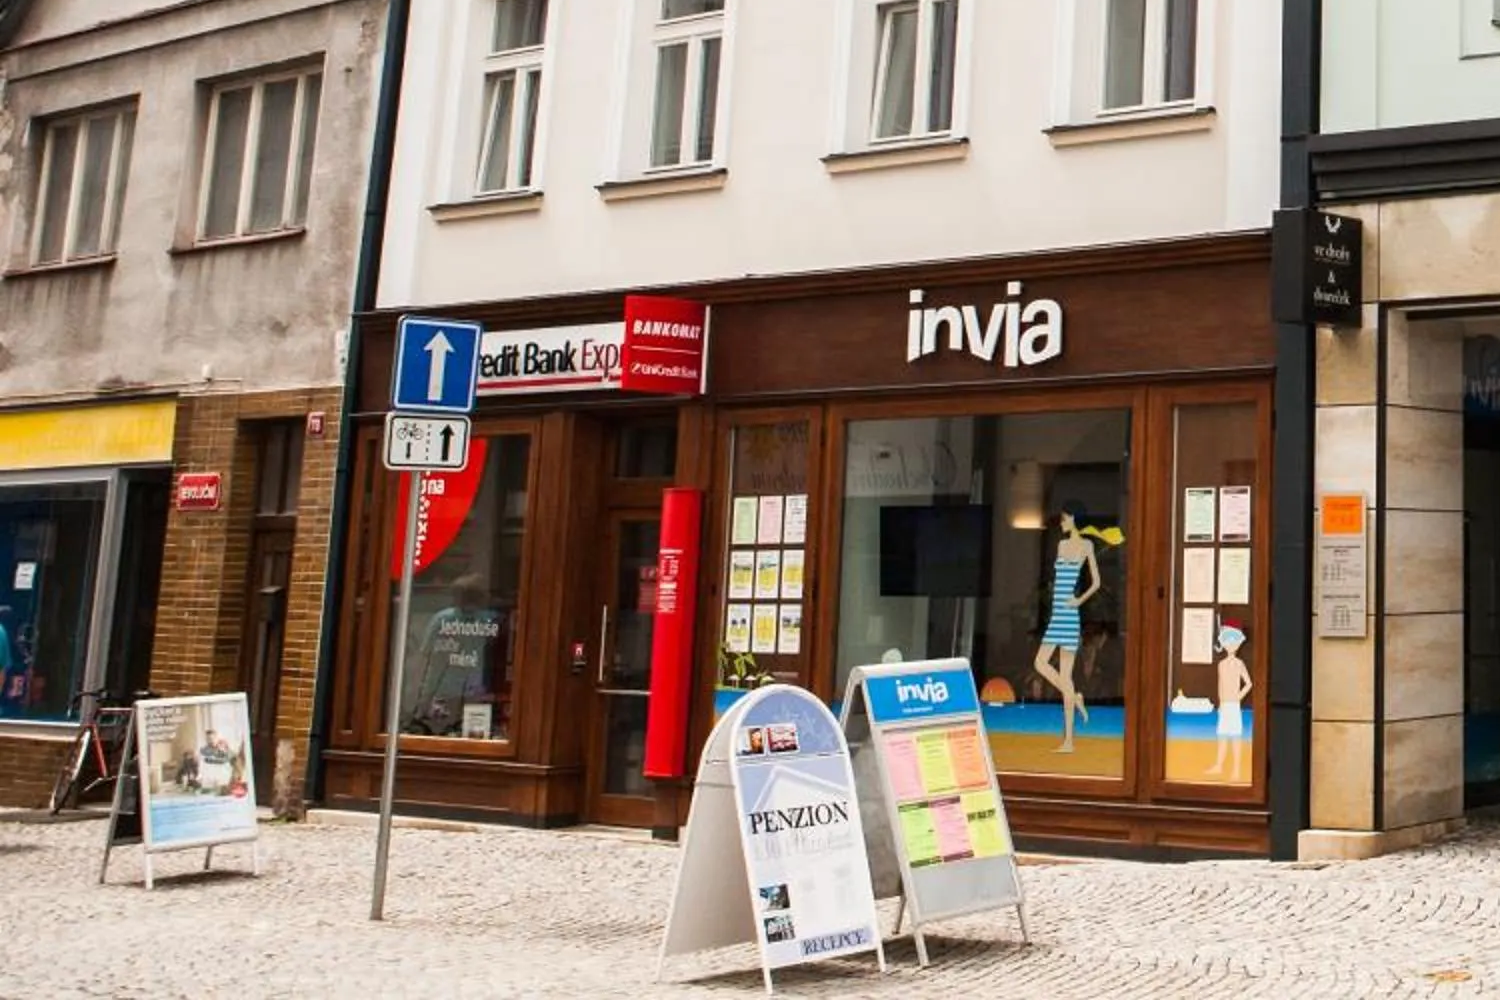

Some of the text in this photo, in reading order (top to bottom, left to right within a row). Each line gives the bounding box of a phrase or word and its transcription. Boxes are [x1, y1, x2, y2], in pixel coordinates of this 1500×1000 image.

[632, 319, 701, 340] BANKOMAT
[907, 280, 1062, 367] invia
[523, 340, 577, 375] Bank
[896, 677, 949, 704] invia
[749, 802, 849, 835] PENZION
